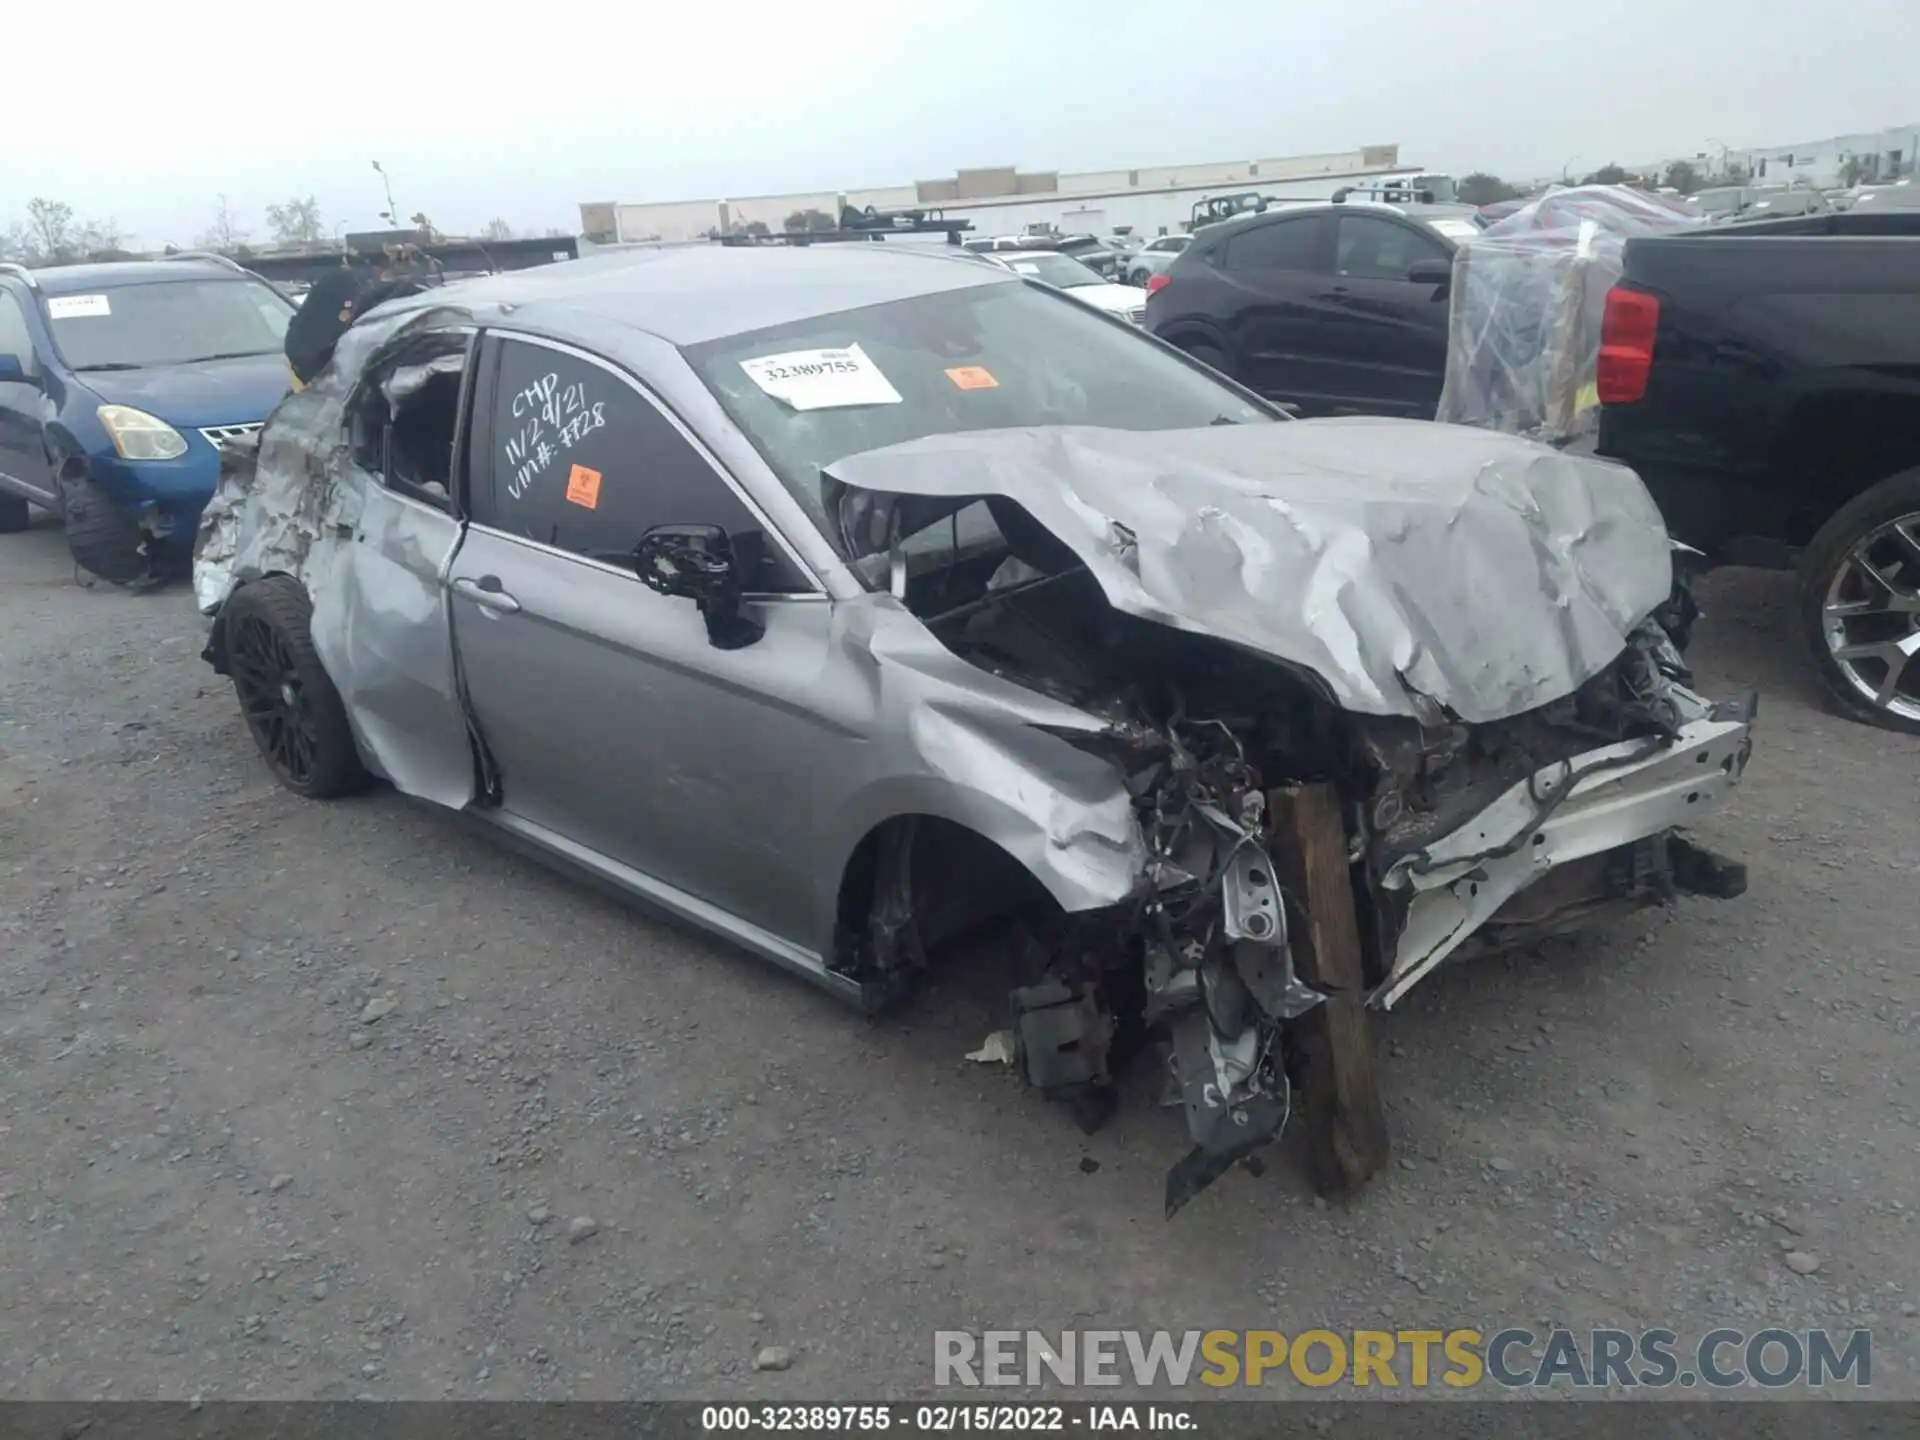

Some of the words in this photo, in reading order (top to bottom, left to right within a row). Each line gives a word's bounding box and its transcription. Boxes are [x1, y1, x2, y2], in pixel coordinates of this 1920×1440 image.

[765, 360, 860, 381] 32389755
[512, 372, 558, 418] CHP
[505, 382, 586, 466] 11/29/21
